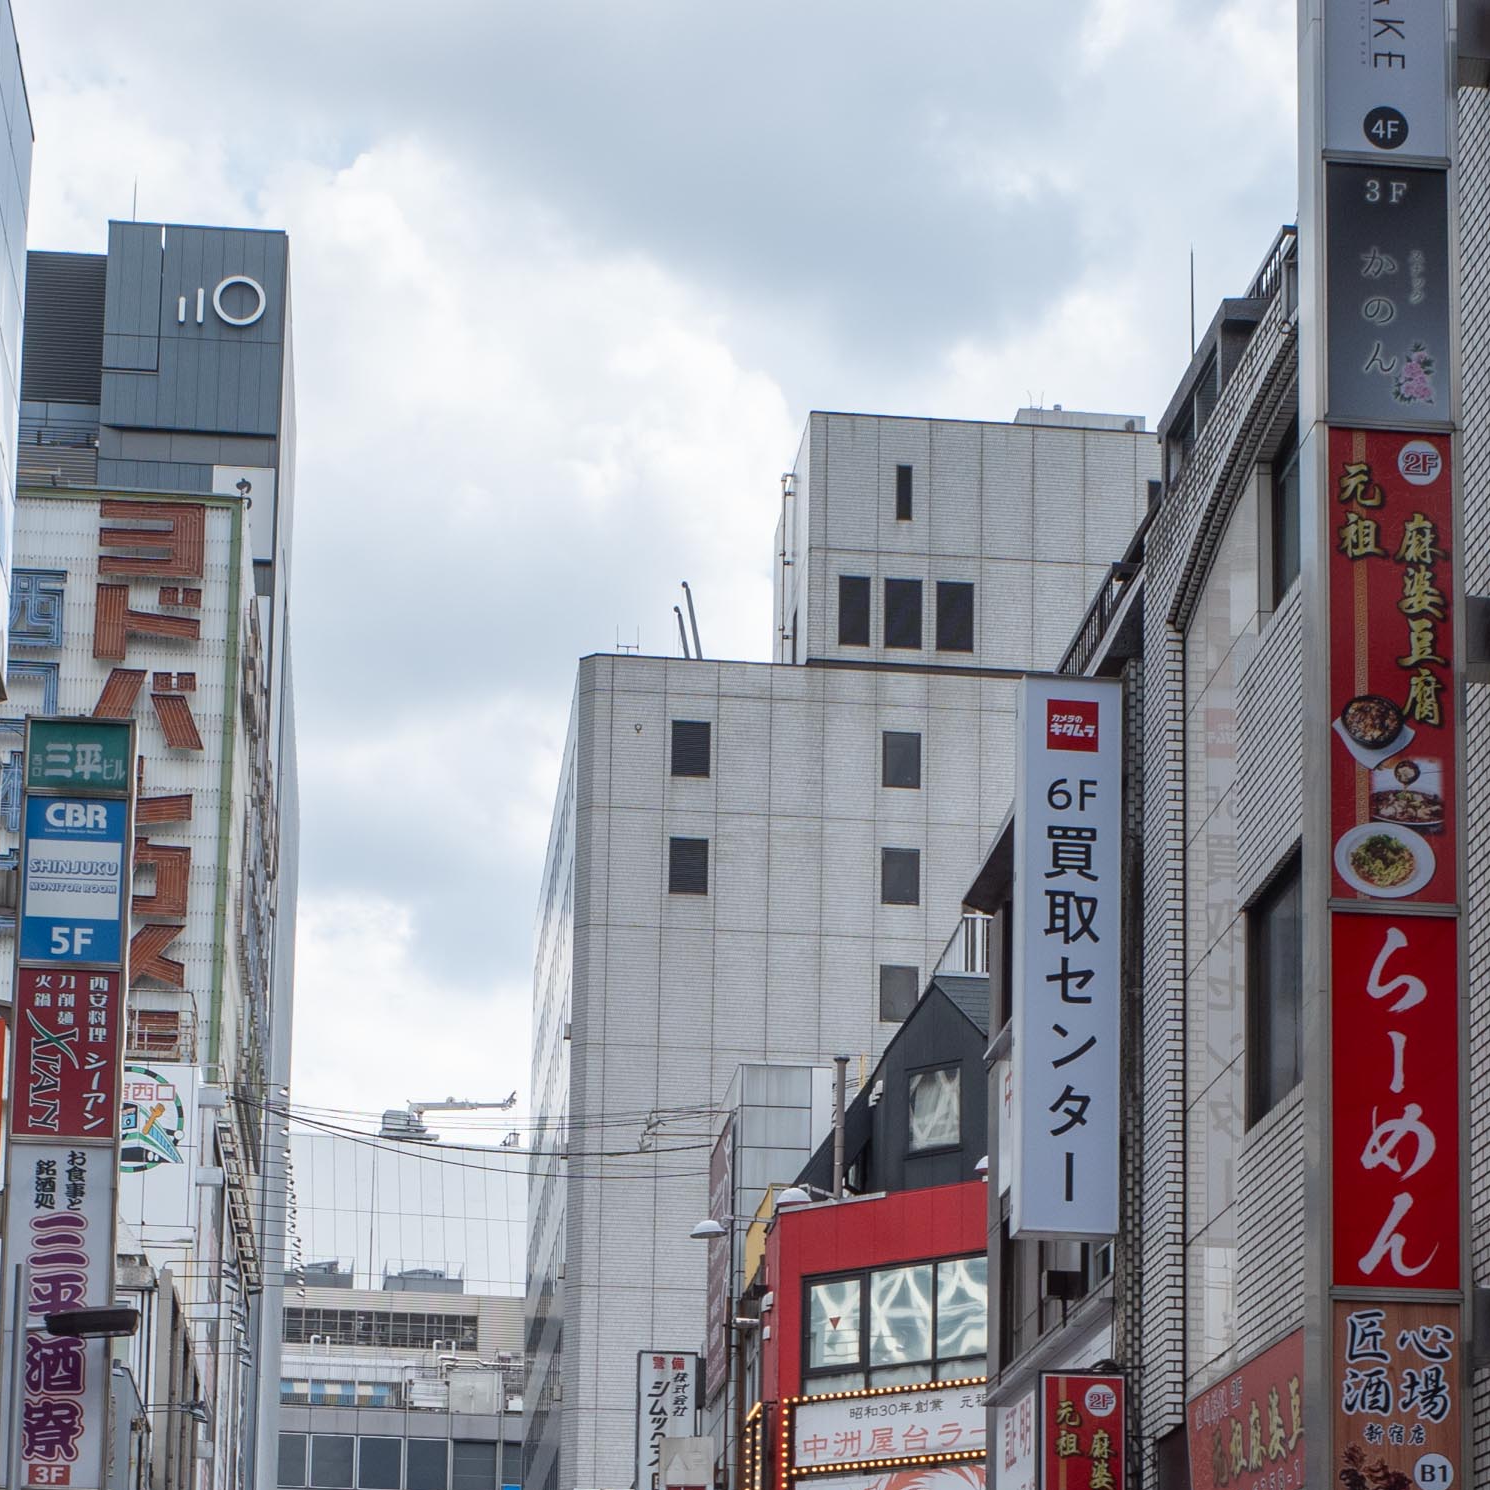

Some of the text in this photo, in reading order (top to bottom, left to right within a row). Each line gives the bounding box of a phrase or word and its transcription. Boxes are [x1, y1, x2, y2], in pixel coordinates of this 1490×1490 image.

[1371, 119, 1400, 140] 4F
[1363, 179, 1409, 205] 3F
[1361, 245, 1398, 377] かのん
[1401, 451, 1439, 475] 2F
[1337, 462, 1387, 560] 元祖
[1393, 511, 1451, 727] 麻婆豆腐
[1047, 721, 1098, 739] キタムラ
[1050, 712, 1085, 725] カメラの
[45, 742, 127, 782] 三平ビル
[1046, 776, 1100, 812] 6F
[45, 802, 109, 829] CBR
[29, 858, 118, 876] SHINJUKU
[29, 882, 117, 895] MONITOR ROOM
[50, 928, 94, 955] 5F
[34, 975, 52, 1008] 火鍋
[56, 975, 77, 1026] 刀削麺
[88, 976, 109, 1044] 西安料理
[1043, 824, 1101, 1203] 買取センター
[82, 1052, 109, 1132] シーアン
[1357, 926, 1440, 1279] らーめん
[34, 1159, 57, 1209] 銘酒処
[64, 1149, 87, 1212] お食事と
[1345, 1307, 1456, 1364] 匠心
[652, 1356, 686, 1371] 警備
[671, 1372, 689, 1417] 株式会社
[848, 1398, 944, 1421] 昭和30年創業
[1087, 1392, 1115, 1411] 2F
[1342, 1365, 1453, 1420] 酒場
[1054, 1399, 1082, 1460] 元祖
[1363, 1422, 1427, 1446] 新宿店
[34, 1466, 65, 1484] 3F
[1418, 1462, 1450, 1483] B1
